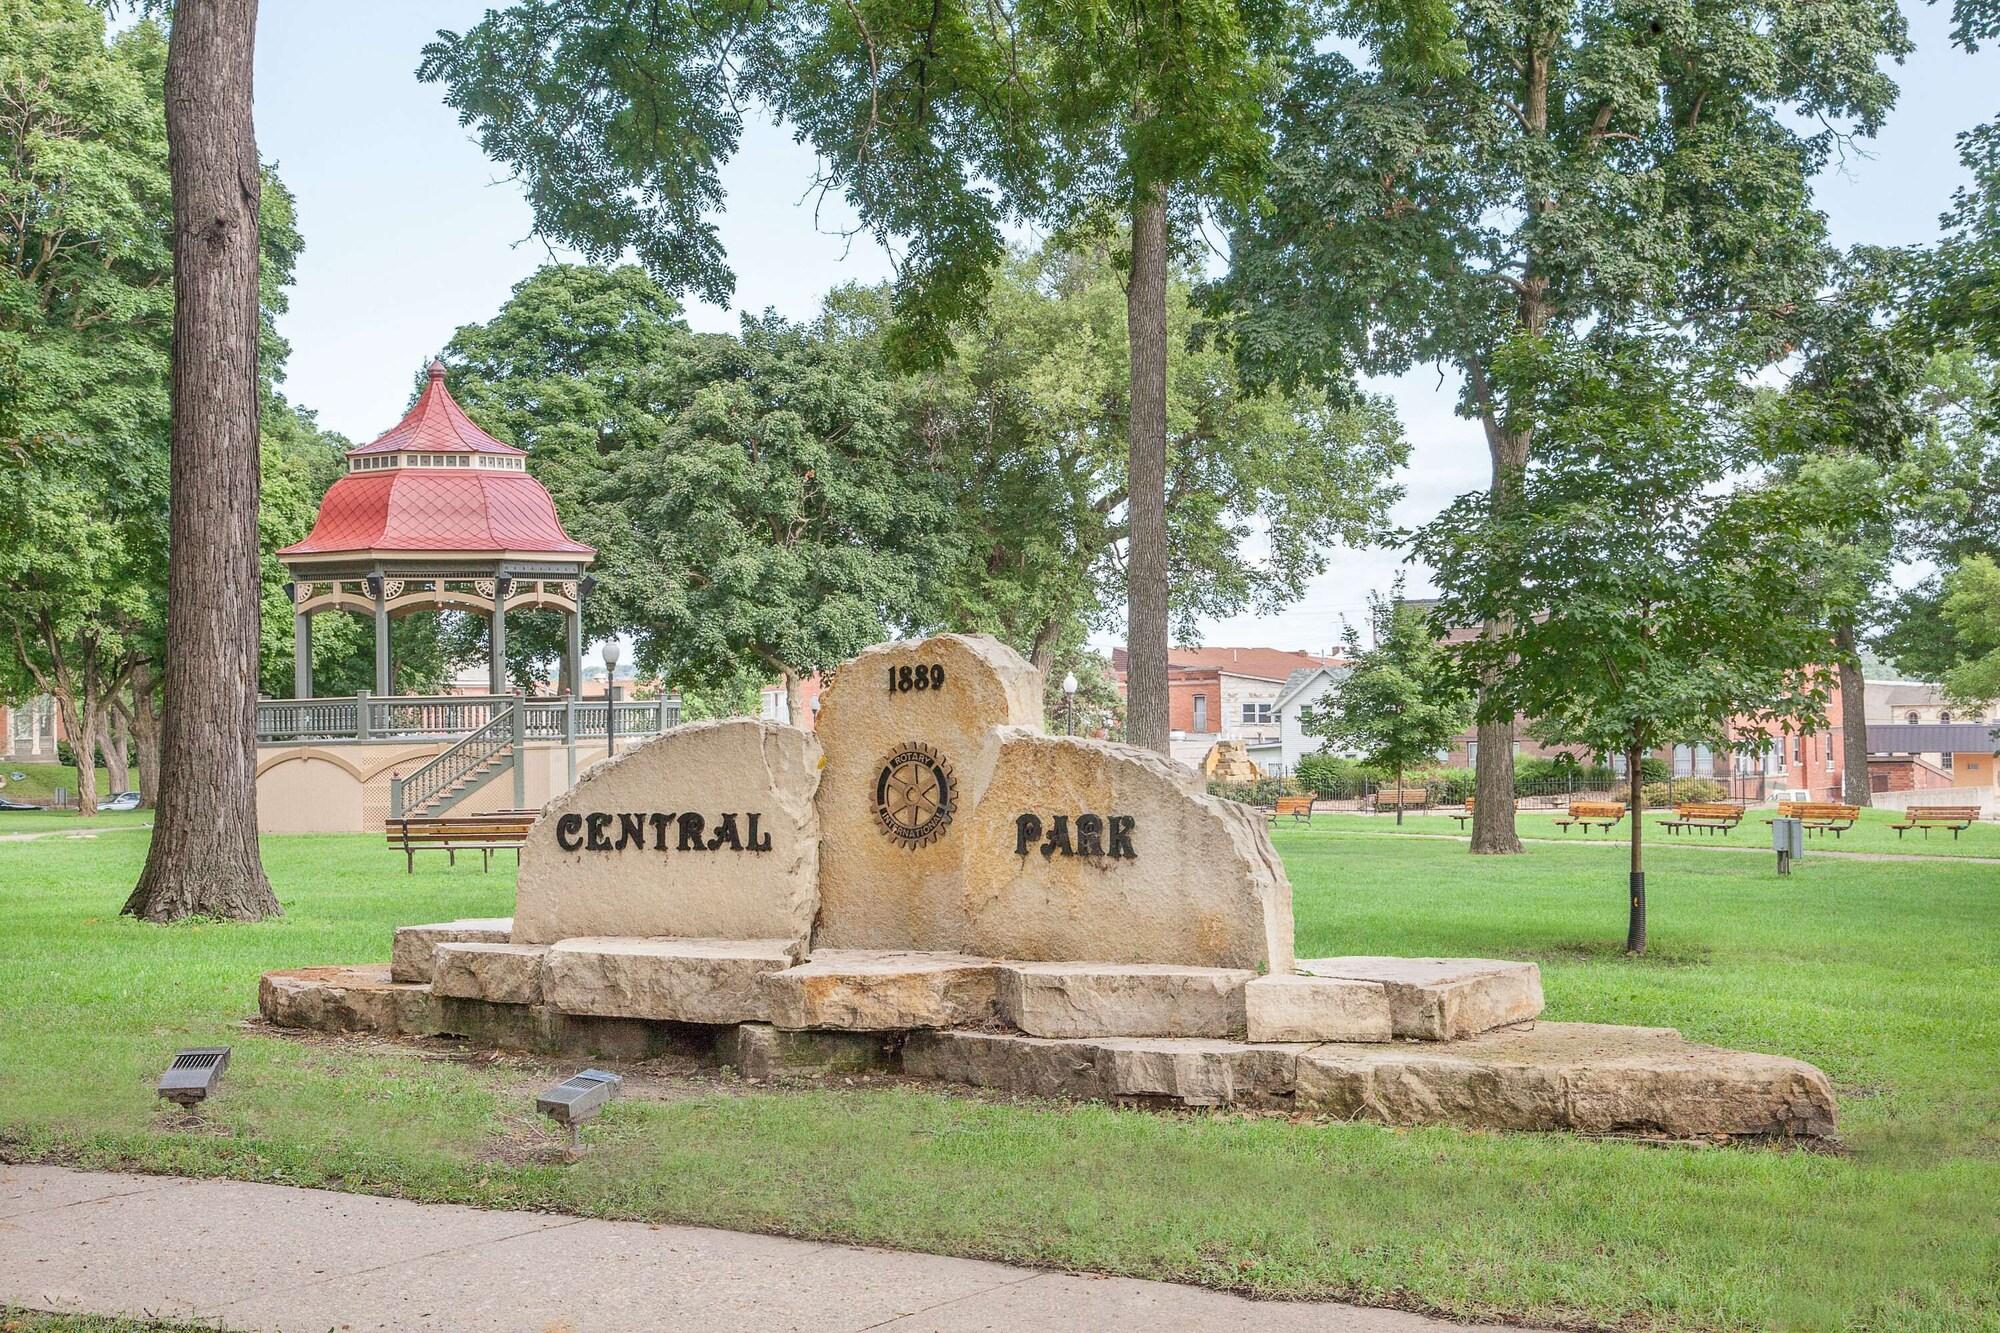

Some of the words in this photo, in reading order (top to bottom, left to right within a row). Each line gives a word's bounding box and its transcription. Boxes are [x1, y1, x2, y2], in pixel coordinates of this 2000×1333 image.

[888, 664, 944, 693] 1889
[894, 752, 931, 765] ROTARY
[557, 812, 772, 852] CENTRAL
[1014, 813, 1138, 859] PARK
[881, 812, 942, 838] INTERNATIONAL
